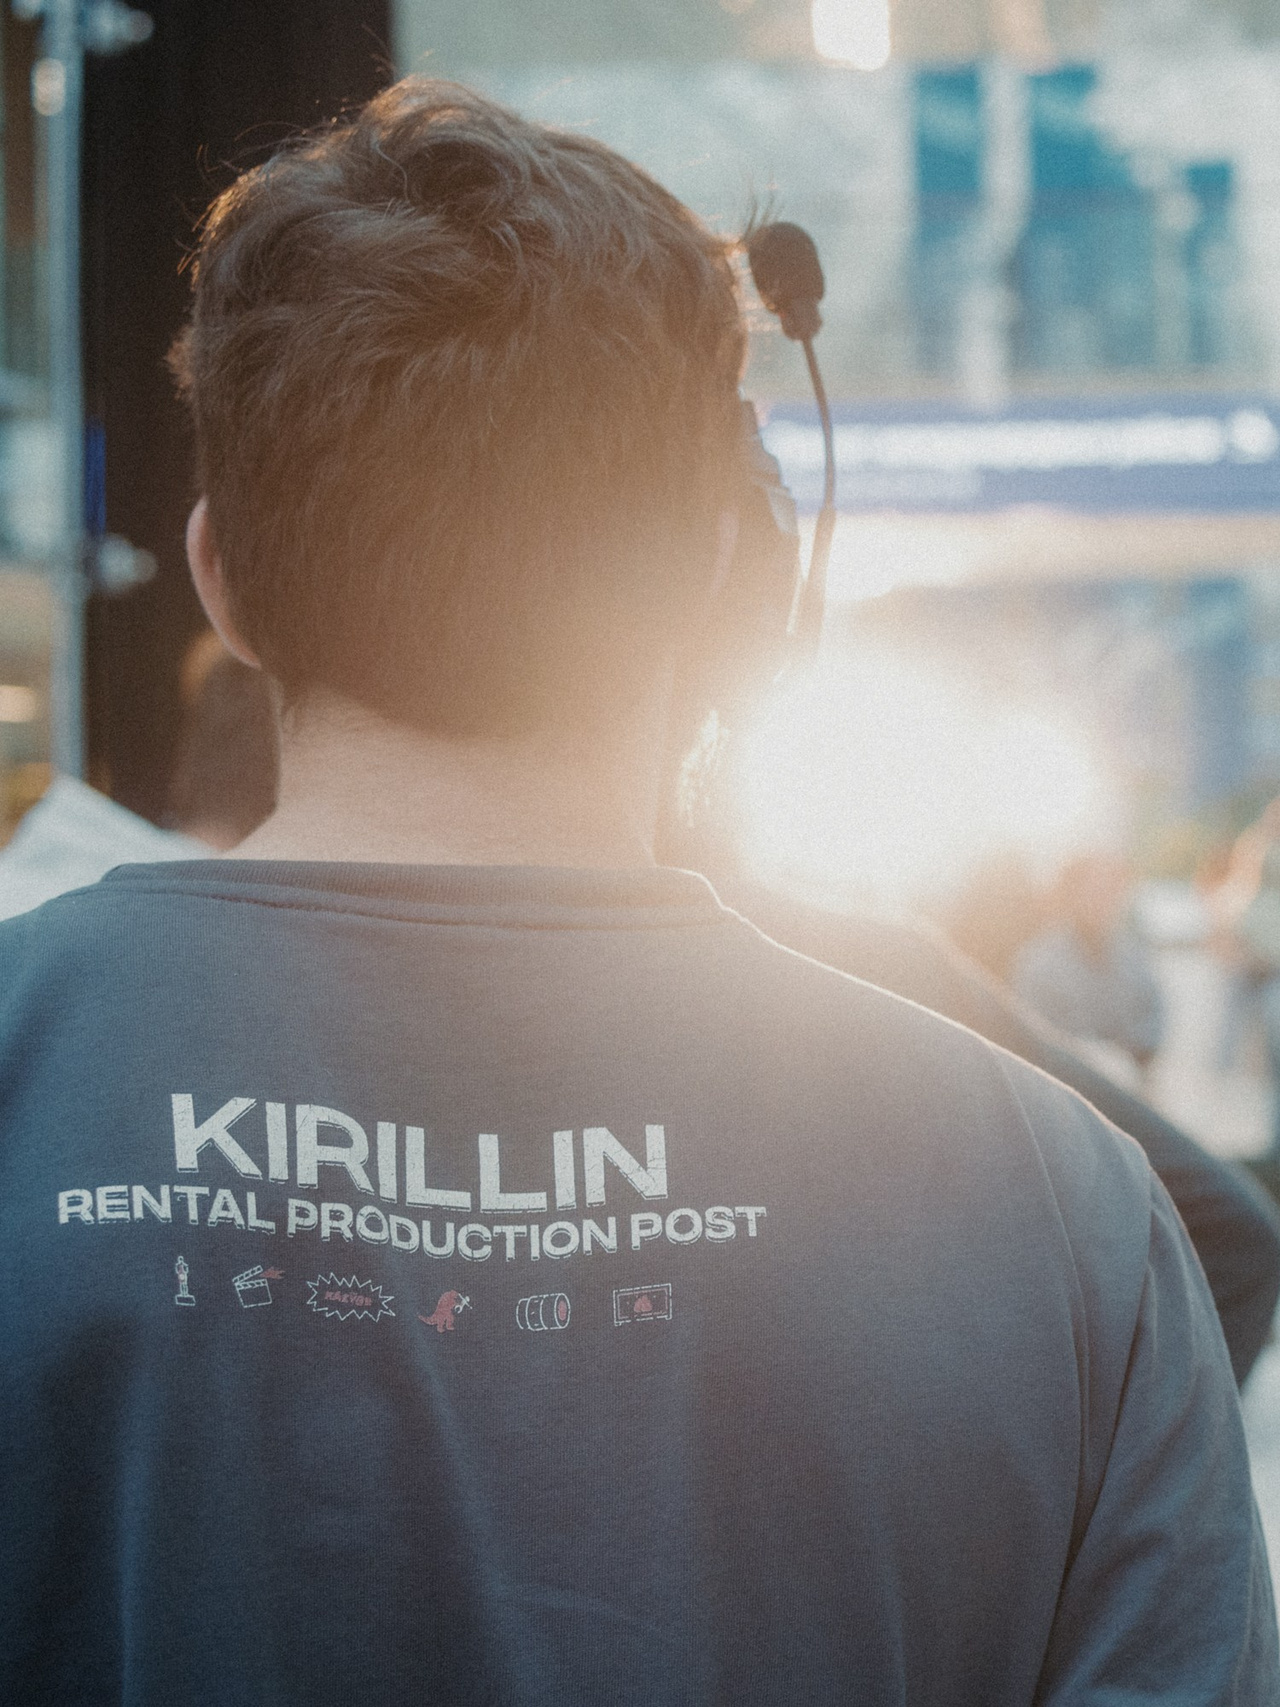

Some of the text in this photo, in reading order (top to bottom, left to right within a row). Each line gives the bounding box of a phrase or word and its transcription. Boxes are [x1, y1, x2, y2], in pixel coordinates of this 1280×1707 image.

[171, 1093, 669, 1213] KIRILLIN
[58, 1184, 767, 1262] RENTAL PRODUCTION POST
